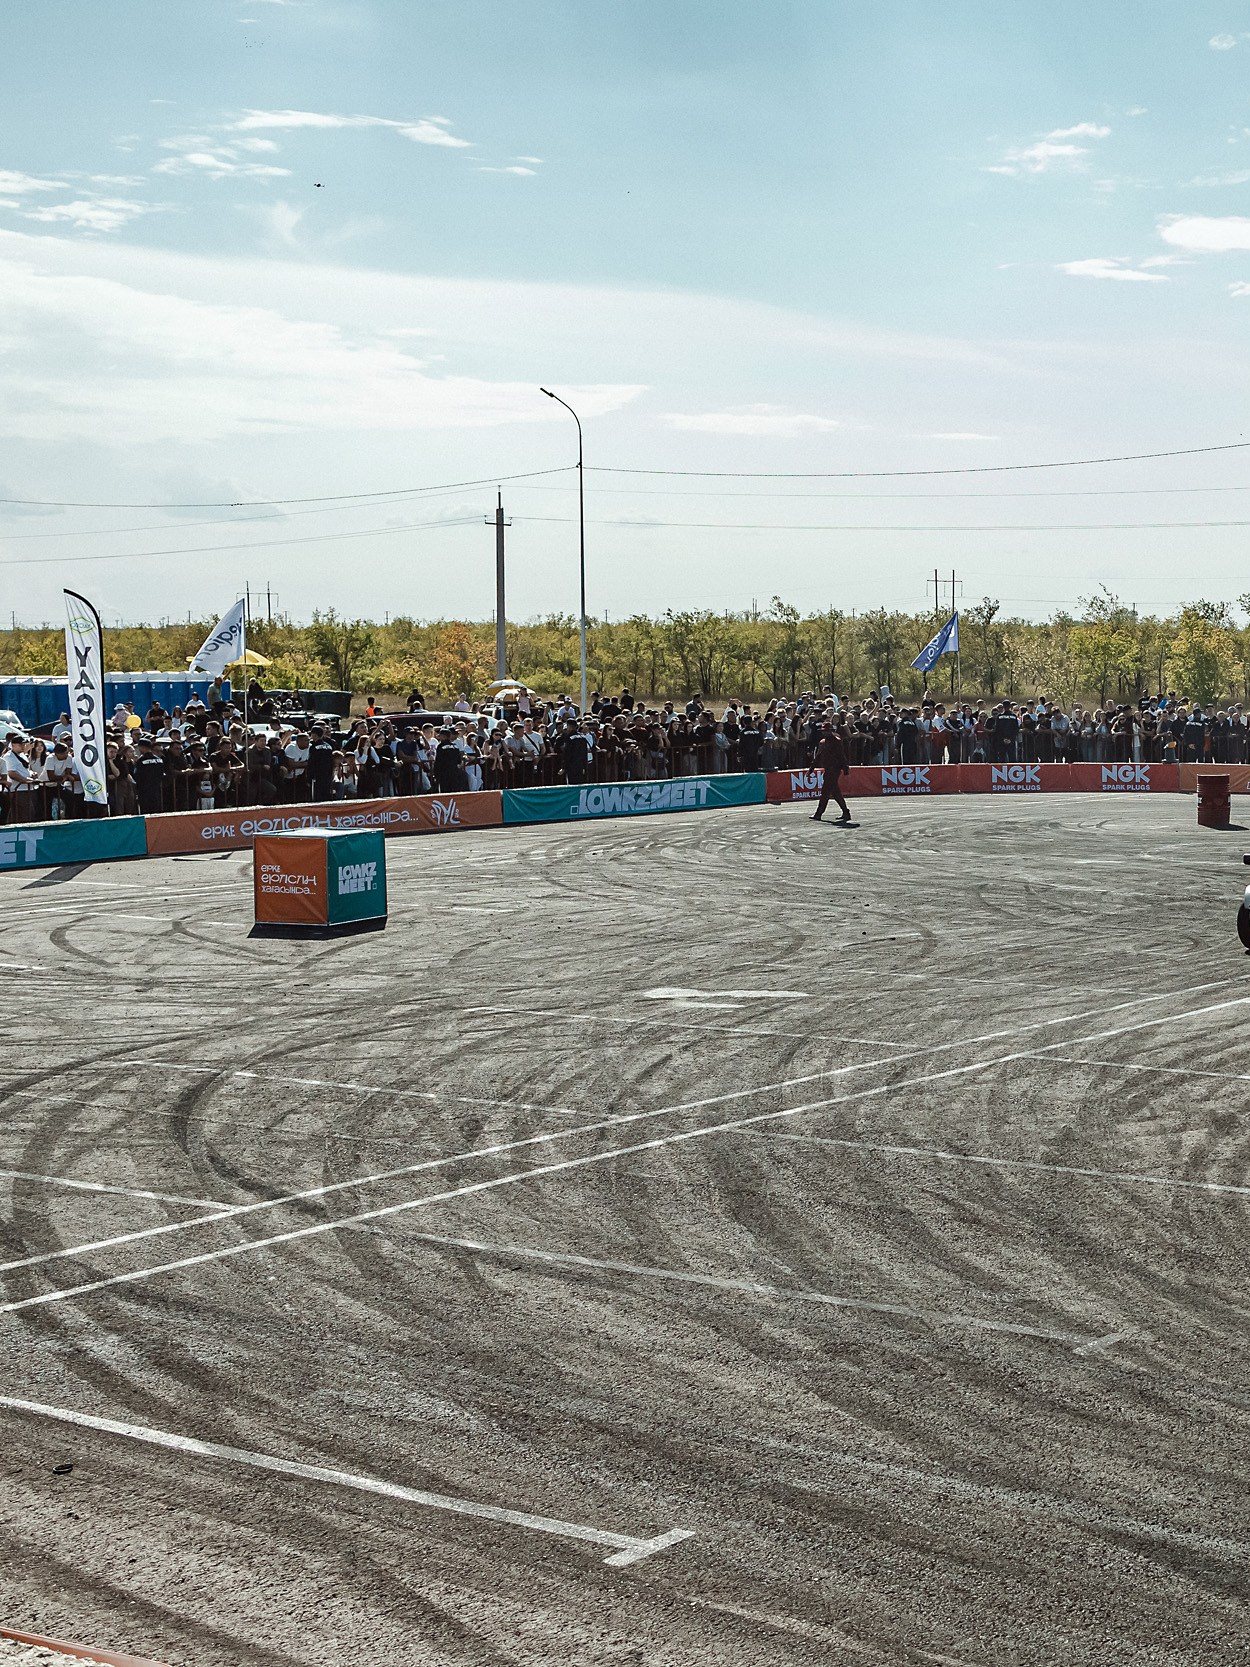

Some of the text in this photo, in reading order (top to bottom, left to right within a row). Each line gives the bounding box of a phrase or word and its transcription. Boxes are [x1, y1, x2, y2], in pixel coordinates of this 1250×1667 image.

[881, 766, 931, 785] NGK
[991, 764, 1041, 783] NGK
[1101, 764, 1151, 783] NGK
[578, 780, 711, 815] LOWKZMEET
[792, 791, 810, 799] SPARK
[338, 861, 377, 881] LOWKZ
